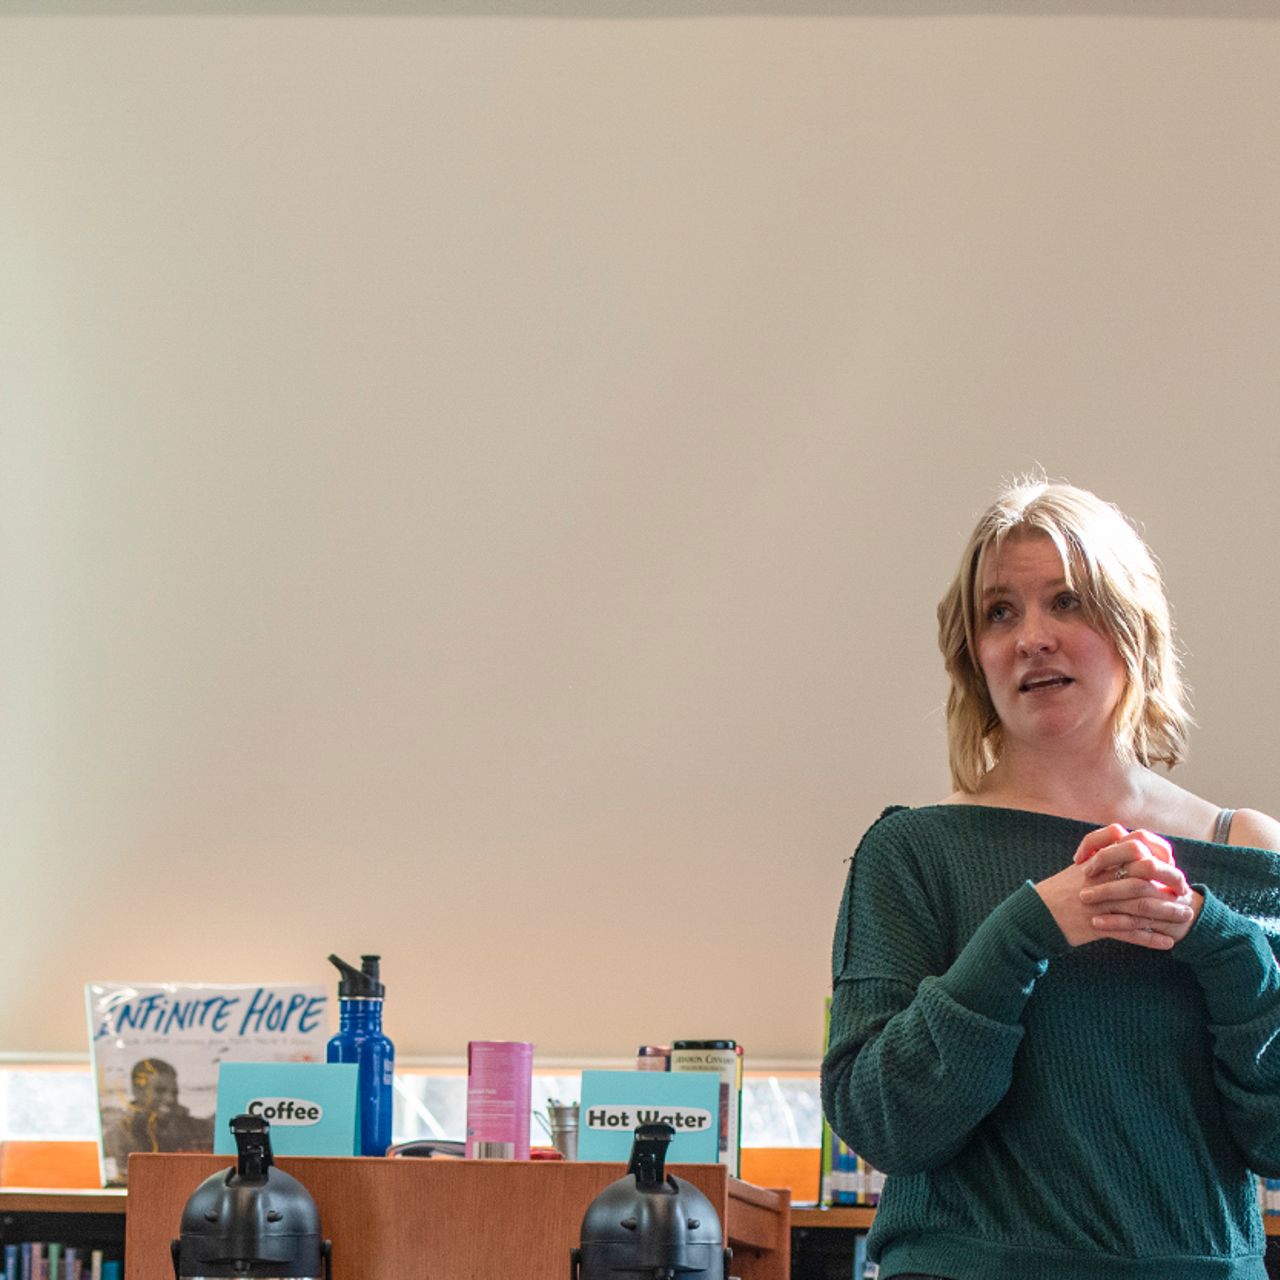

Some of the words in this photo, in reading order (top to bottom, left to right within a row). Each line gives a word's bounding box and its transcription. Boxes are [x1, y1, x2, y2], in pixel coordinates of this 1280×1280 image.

[239, 988, 328, 1036] HOPE
[248, 1100, 320, 1121] Coffee
[588, 1110, 630, 1128] Hot
[636, 1110, 707, 1128] Water
